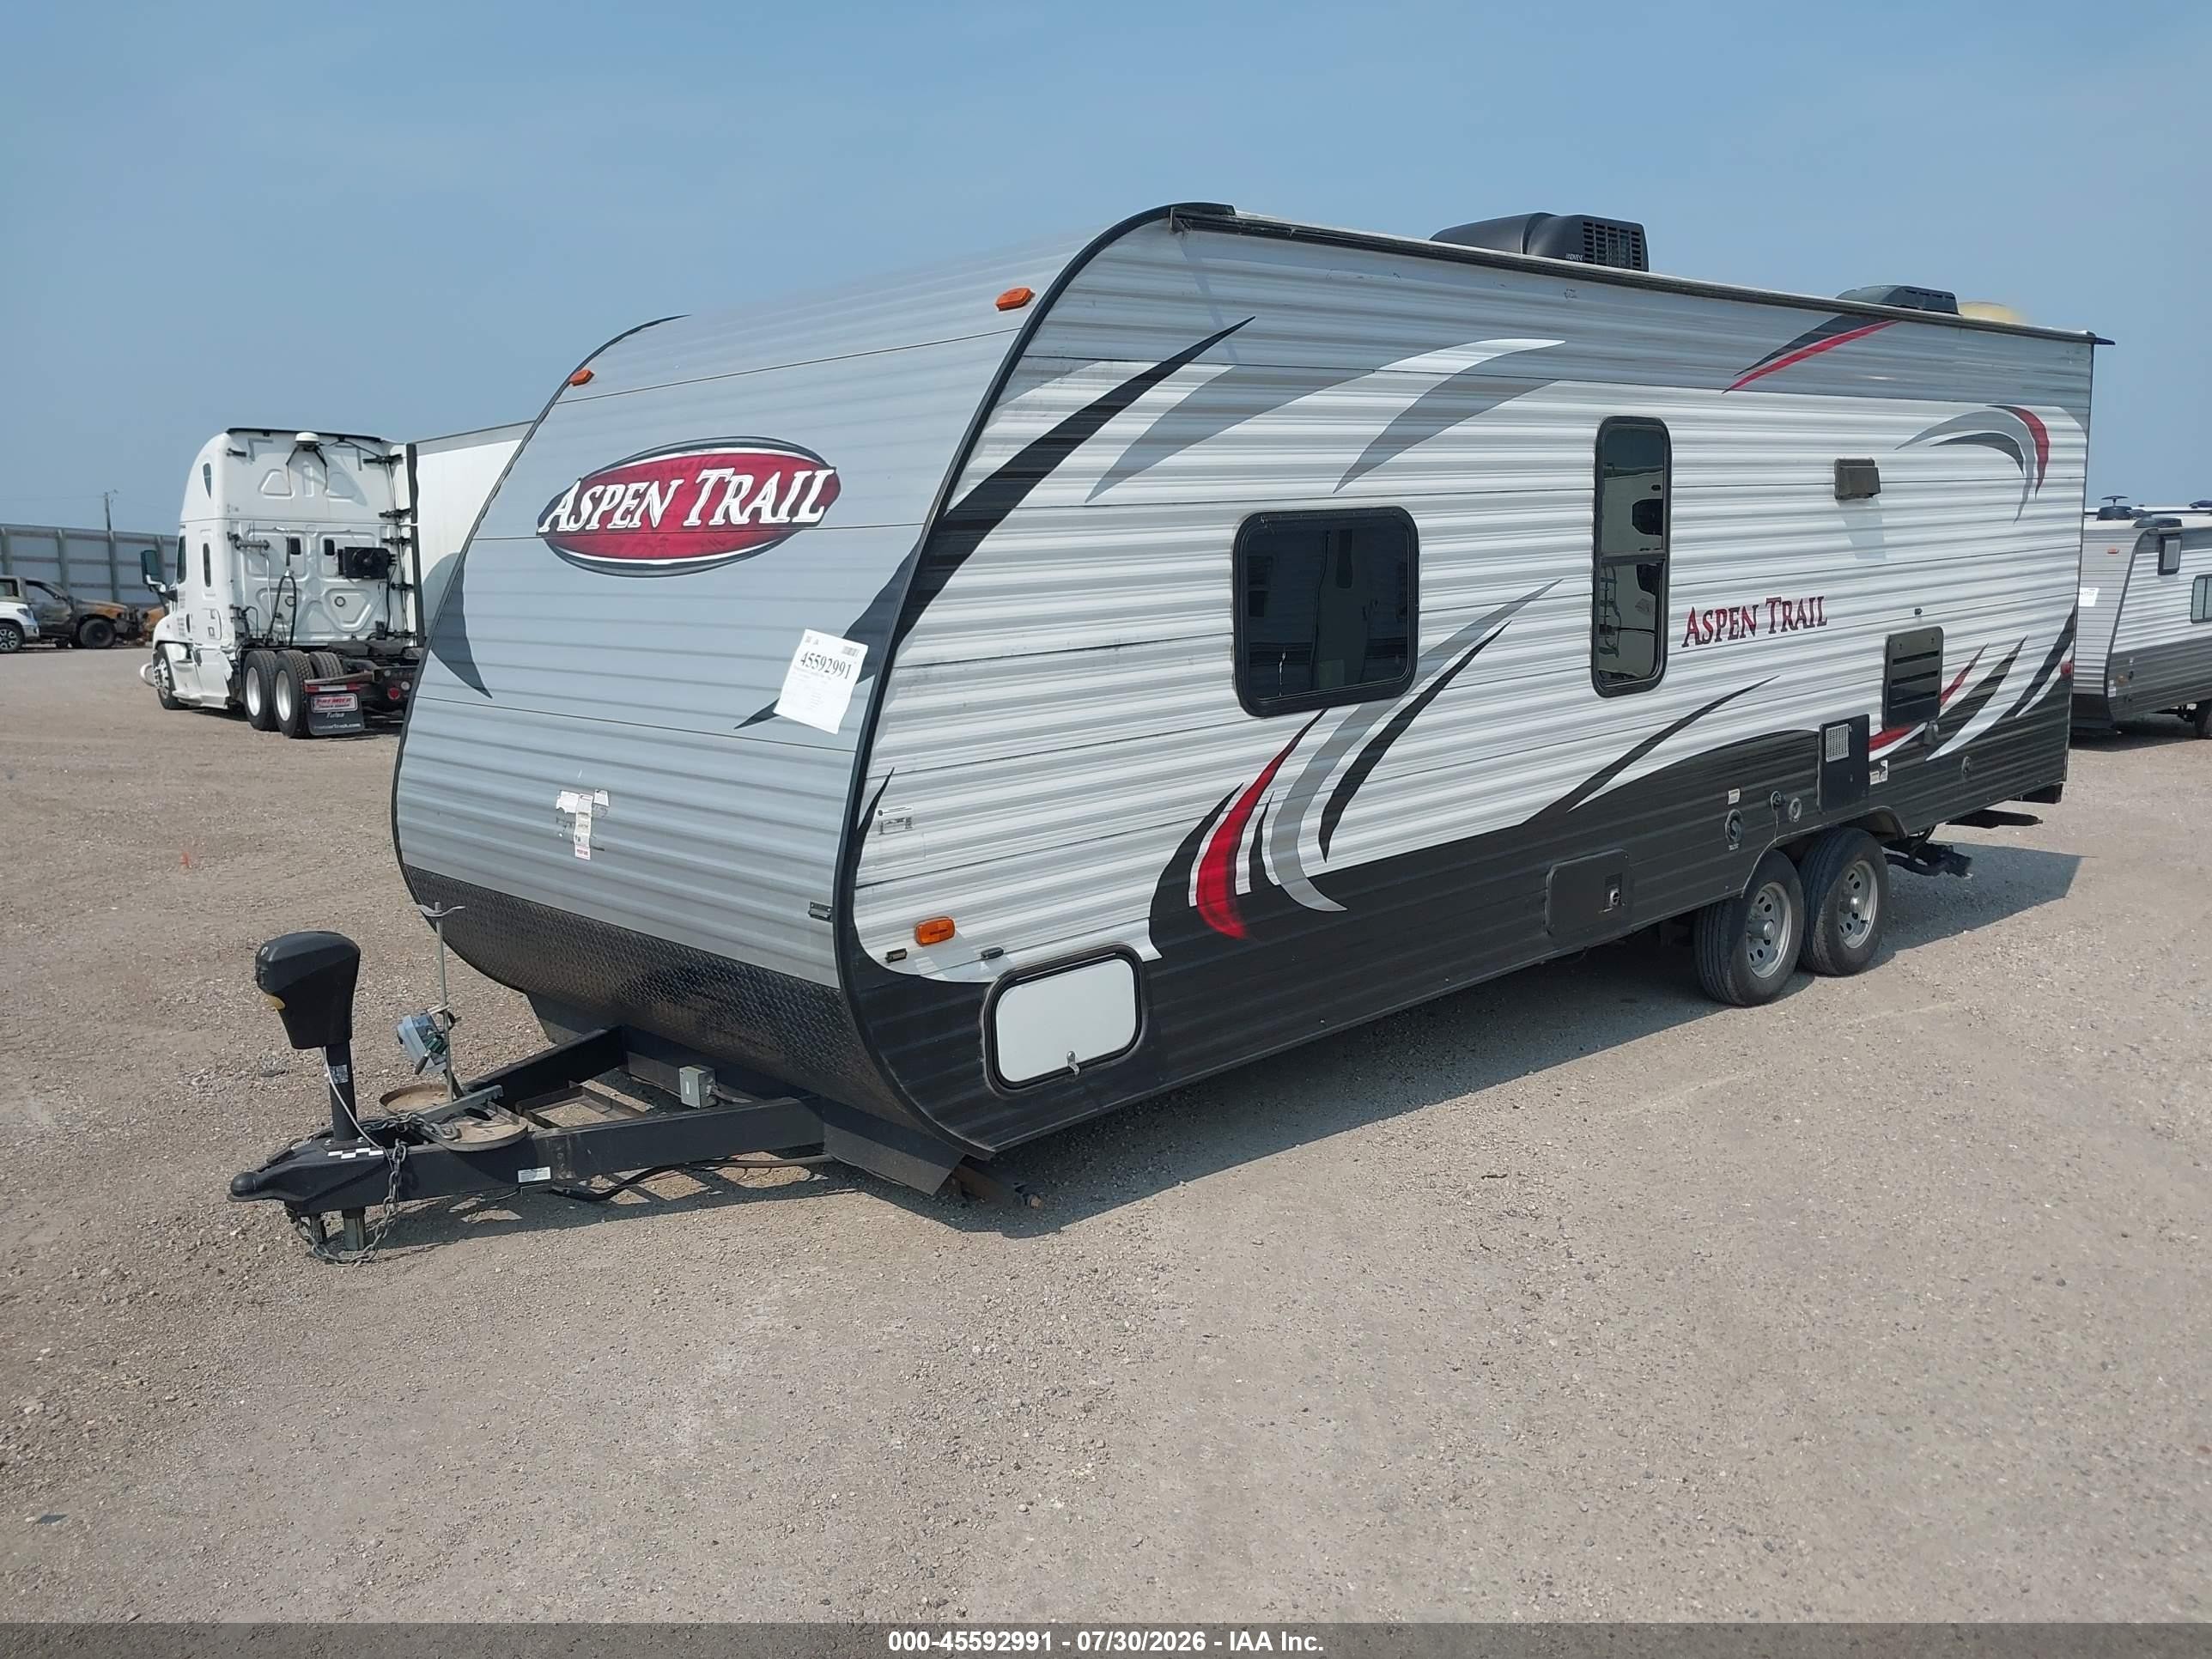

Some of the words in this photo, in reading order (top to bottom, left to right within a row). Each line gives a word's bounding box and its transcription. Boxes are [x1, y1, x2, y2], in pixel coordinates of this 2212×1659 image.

[537, 478, 684, 534] ASPEN
[682, 467, 836, 527] TRAIL
[1681, 605, 1759, 648] ASPEN
[1765, 596, 1828, 635] TRAIL
[799, 651, 852, 680] 45592991
